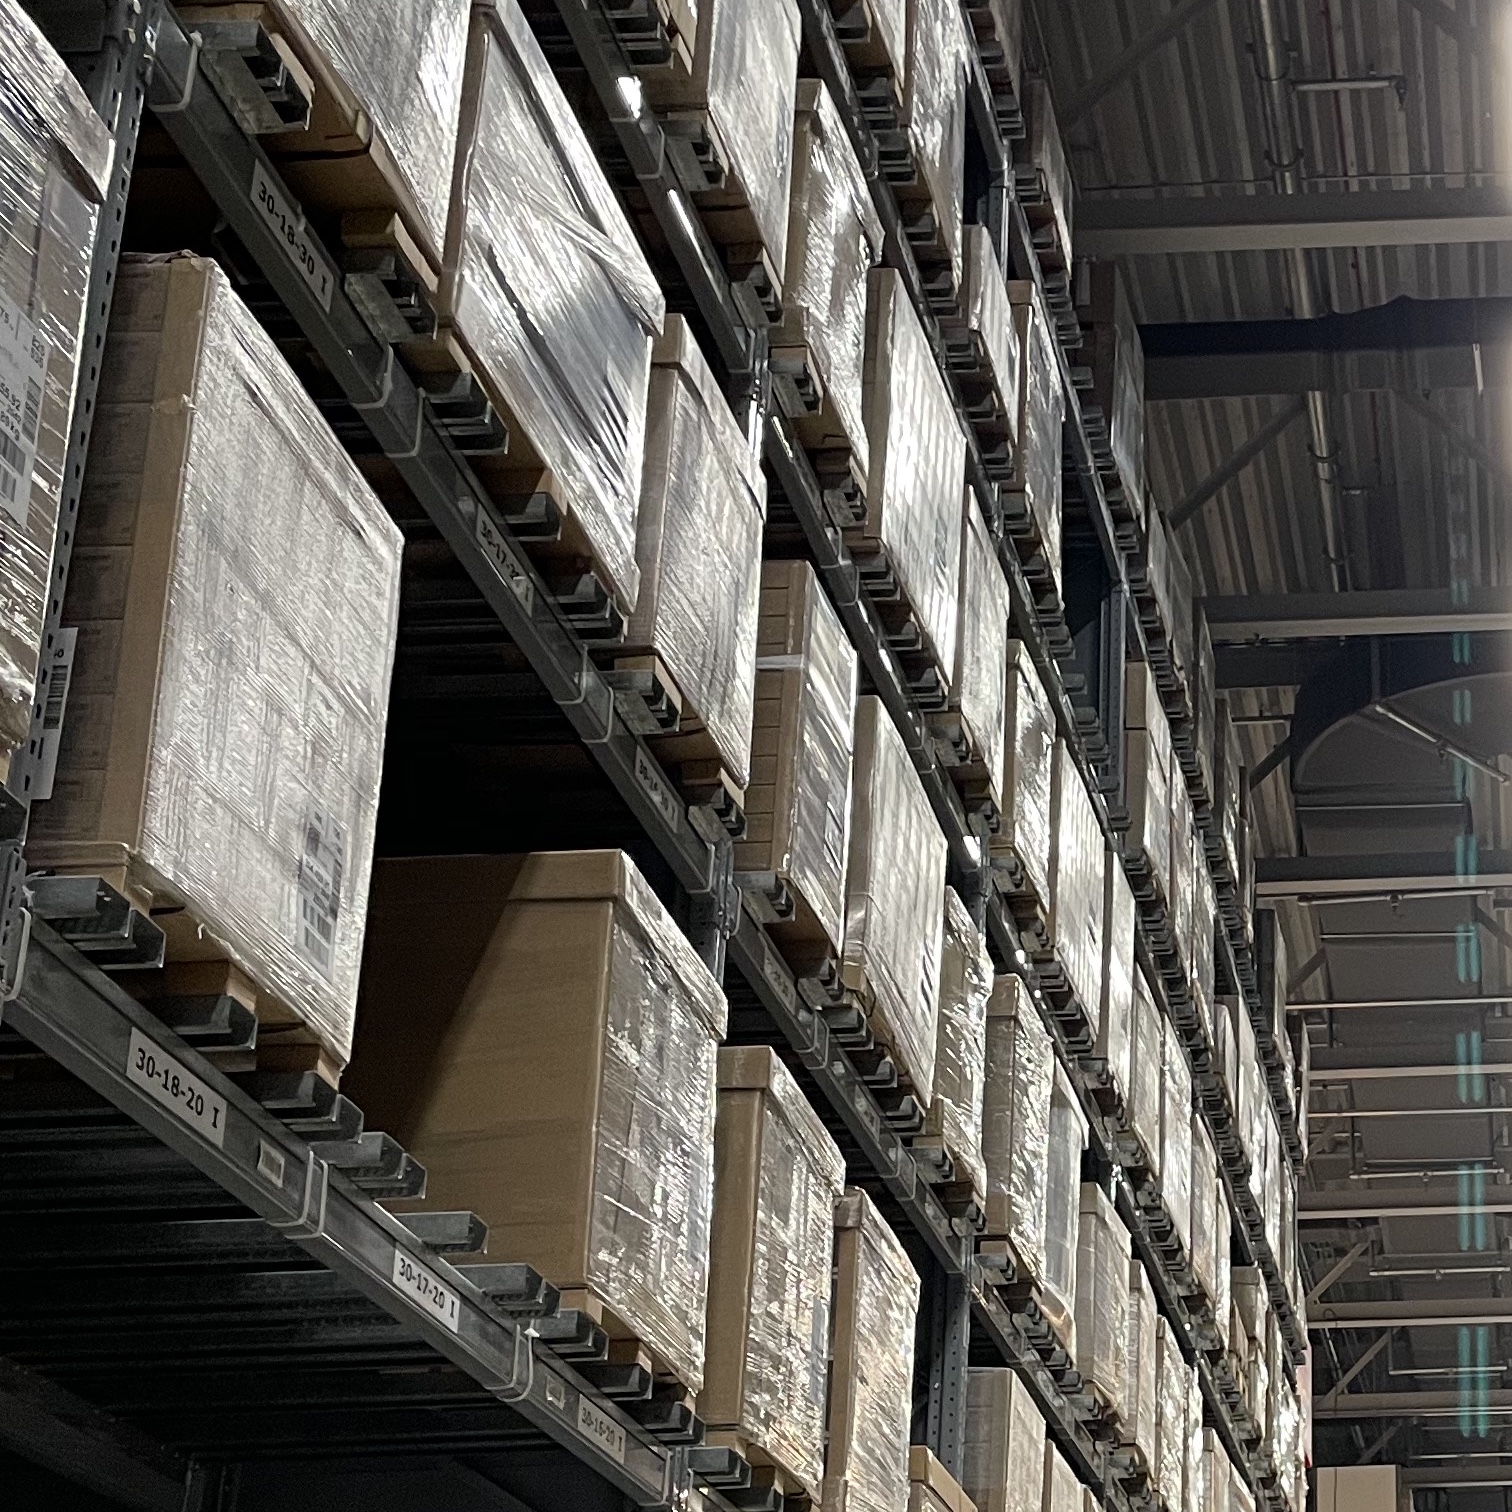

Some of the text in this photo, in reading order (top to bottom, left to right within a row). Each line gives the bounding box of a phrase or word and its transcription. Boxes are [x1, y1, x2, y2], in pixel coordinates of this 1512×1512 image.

[258, 181, 315, 275] 30-18-30
[135, 1047, 204, 1116] 30-18-20
[399, 1257, 446, 1309] 30-17-20
